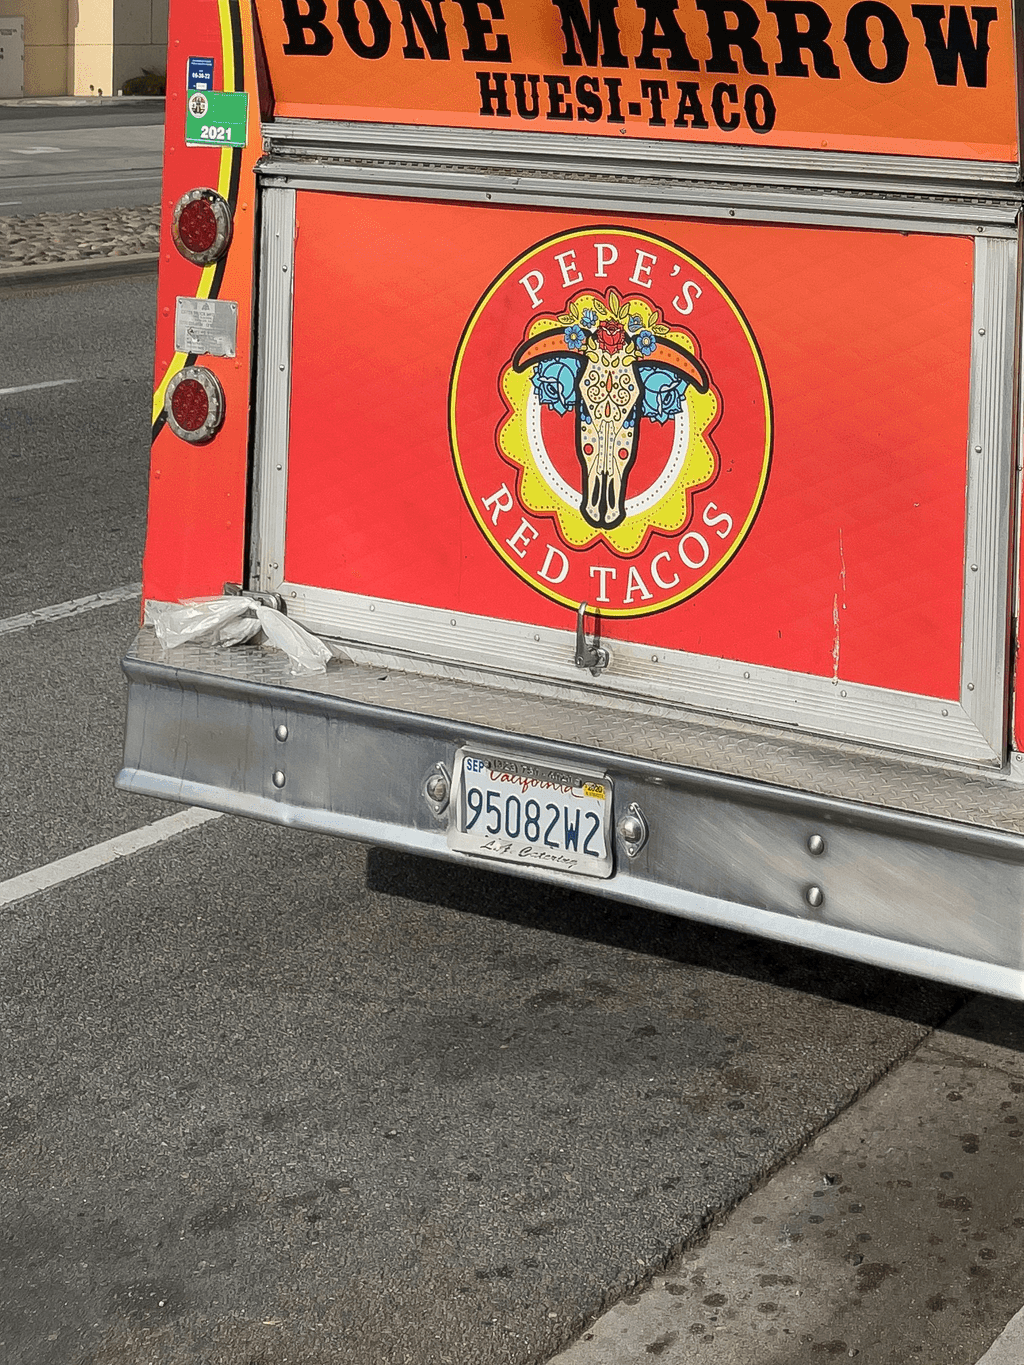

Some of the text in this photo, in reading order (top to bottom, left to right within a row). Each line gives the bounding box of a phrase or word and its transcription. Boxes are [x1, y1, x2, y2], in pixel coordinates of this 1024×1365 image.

[200, 125, 231, 141] 2021
[478, 71, 777, 134] HUESI-TACO
[519, 243, 702, 315] PEPE'S
[481, 483, 733, 604] RED TACOS
[466, 758, 484, 773] SEP
[465, 787, 600, 858] 95082W2
